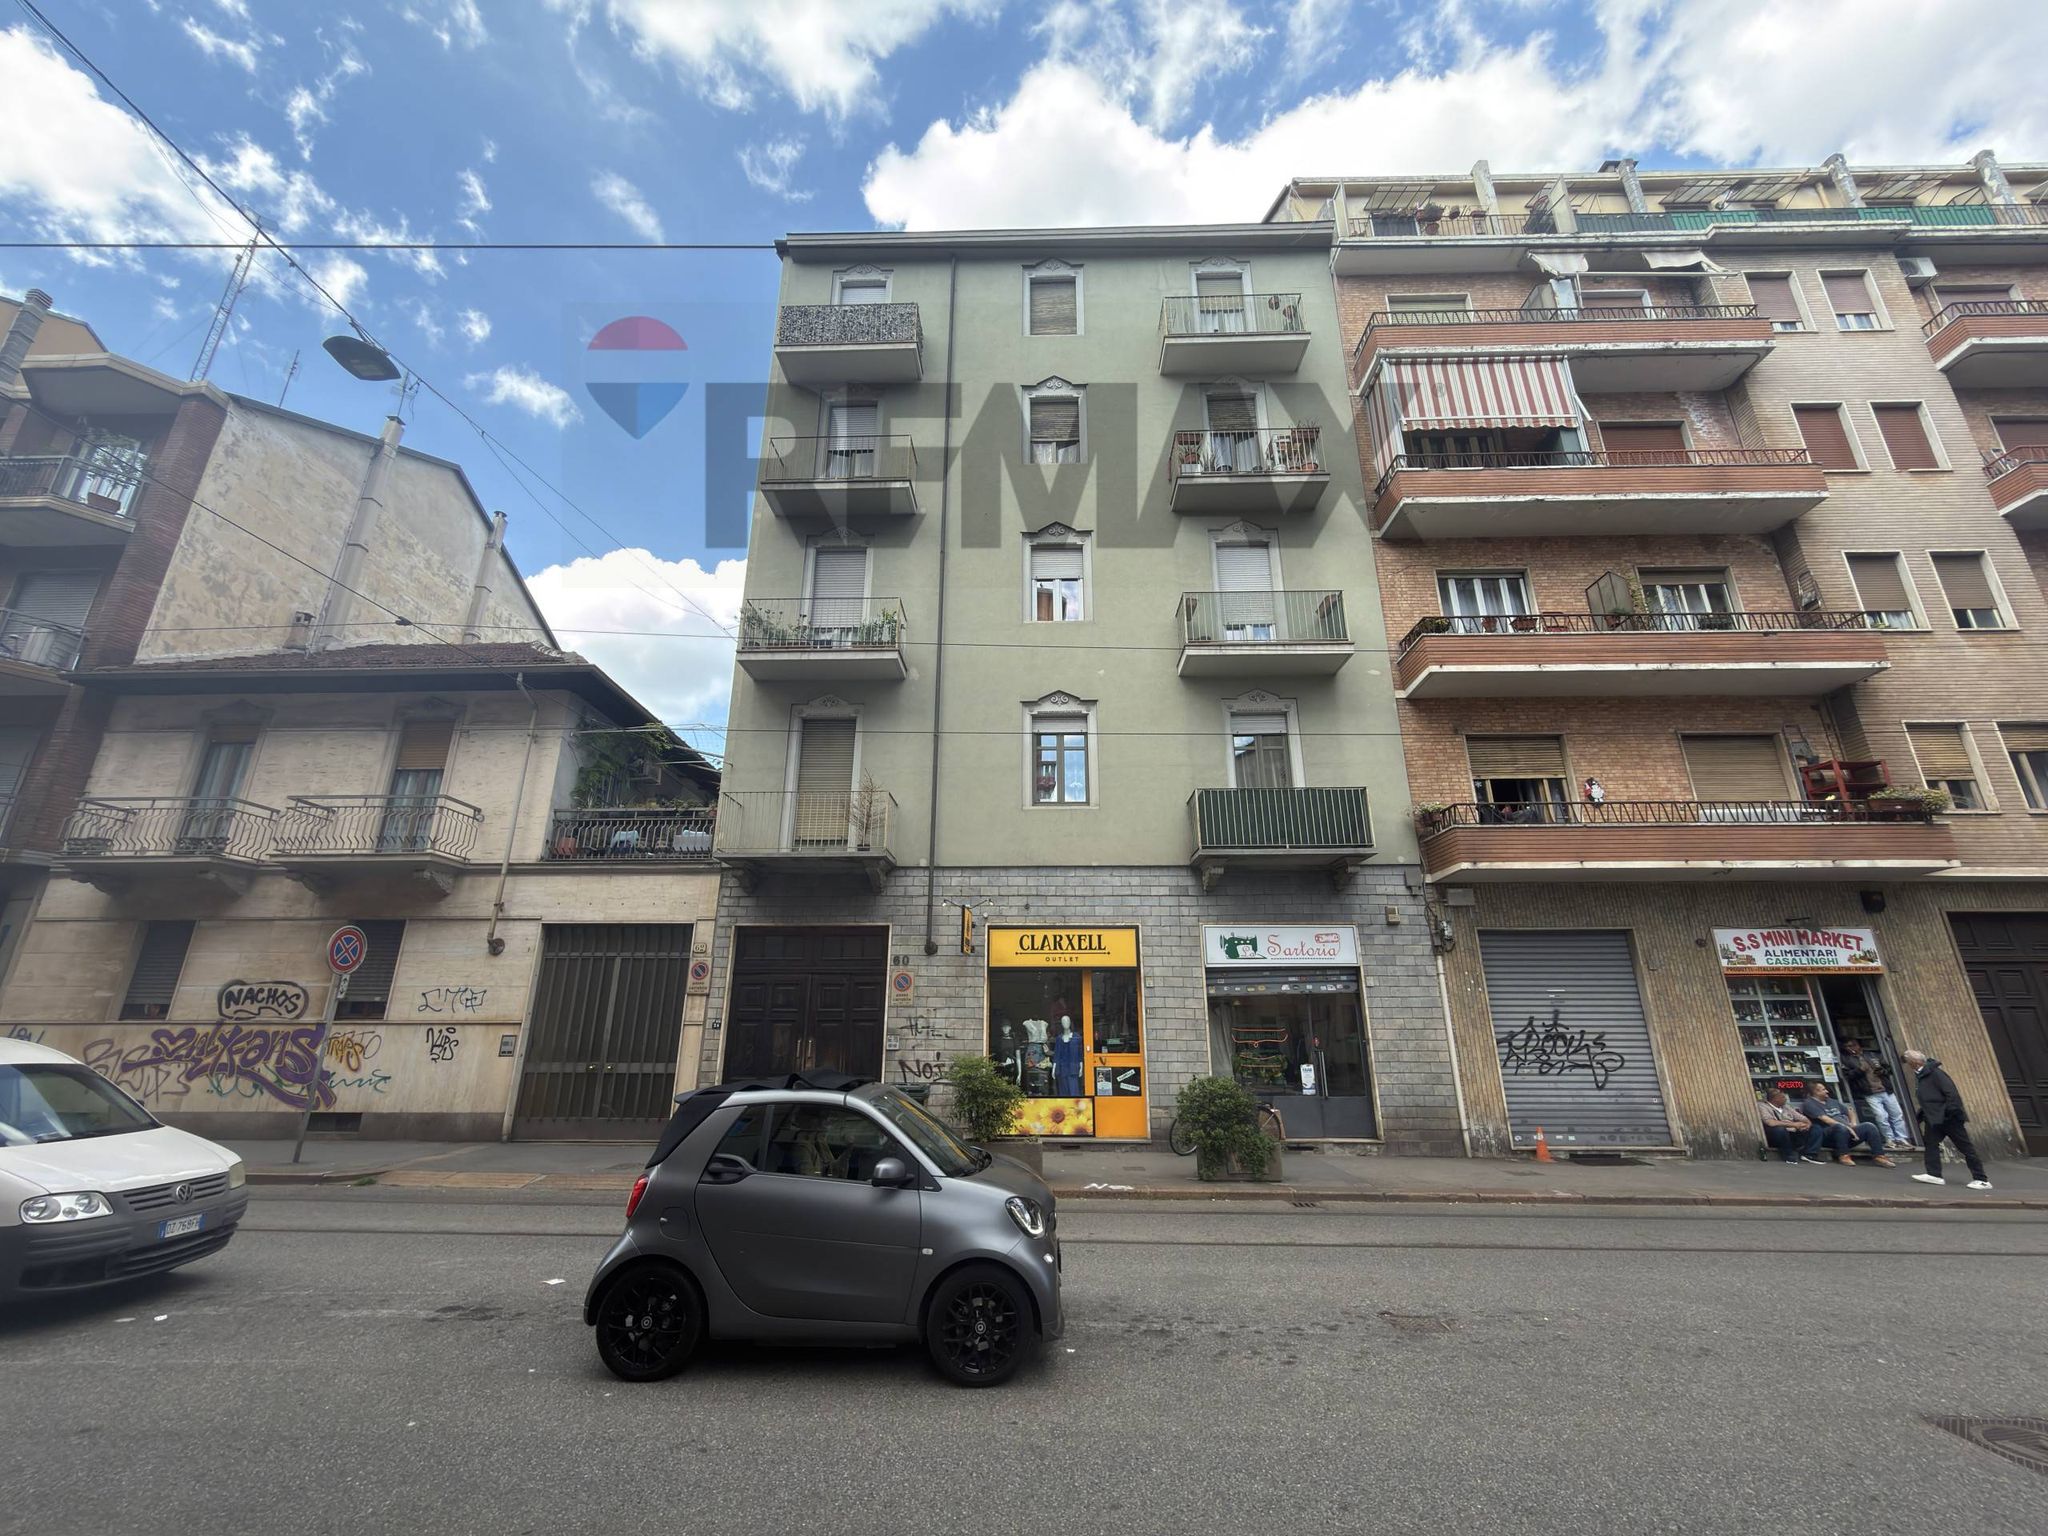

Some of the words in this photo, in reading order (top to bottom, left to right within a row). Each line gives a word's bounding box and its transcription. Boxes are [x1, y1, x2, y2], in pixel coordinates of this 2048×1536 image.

[1019, 934, 1106, 951] CLARXELL
[1267, 934, 1337, 956] Sartoria
[1760, 928, 1796, 947] MINI
[1797, 928, 1864, 951] MARKET
[893, 955, 909, 966] 60
[1764, 949, 1838, 957] ALIMENTARI
[1766, 958, 1839, 966] CASALINGHI
[225, 987, 301, 1014] NACHOS
